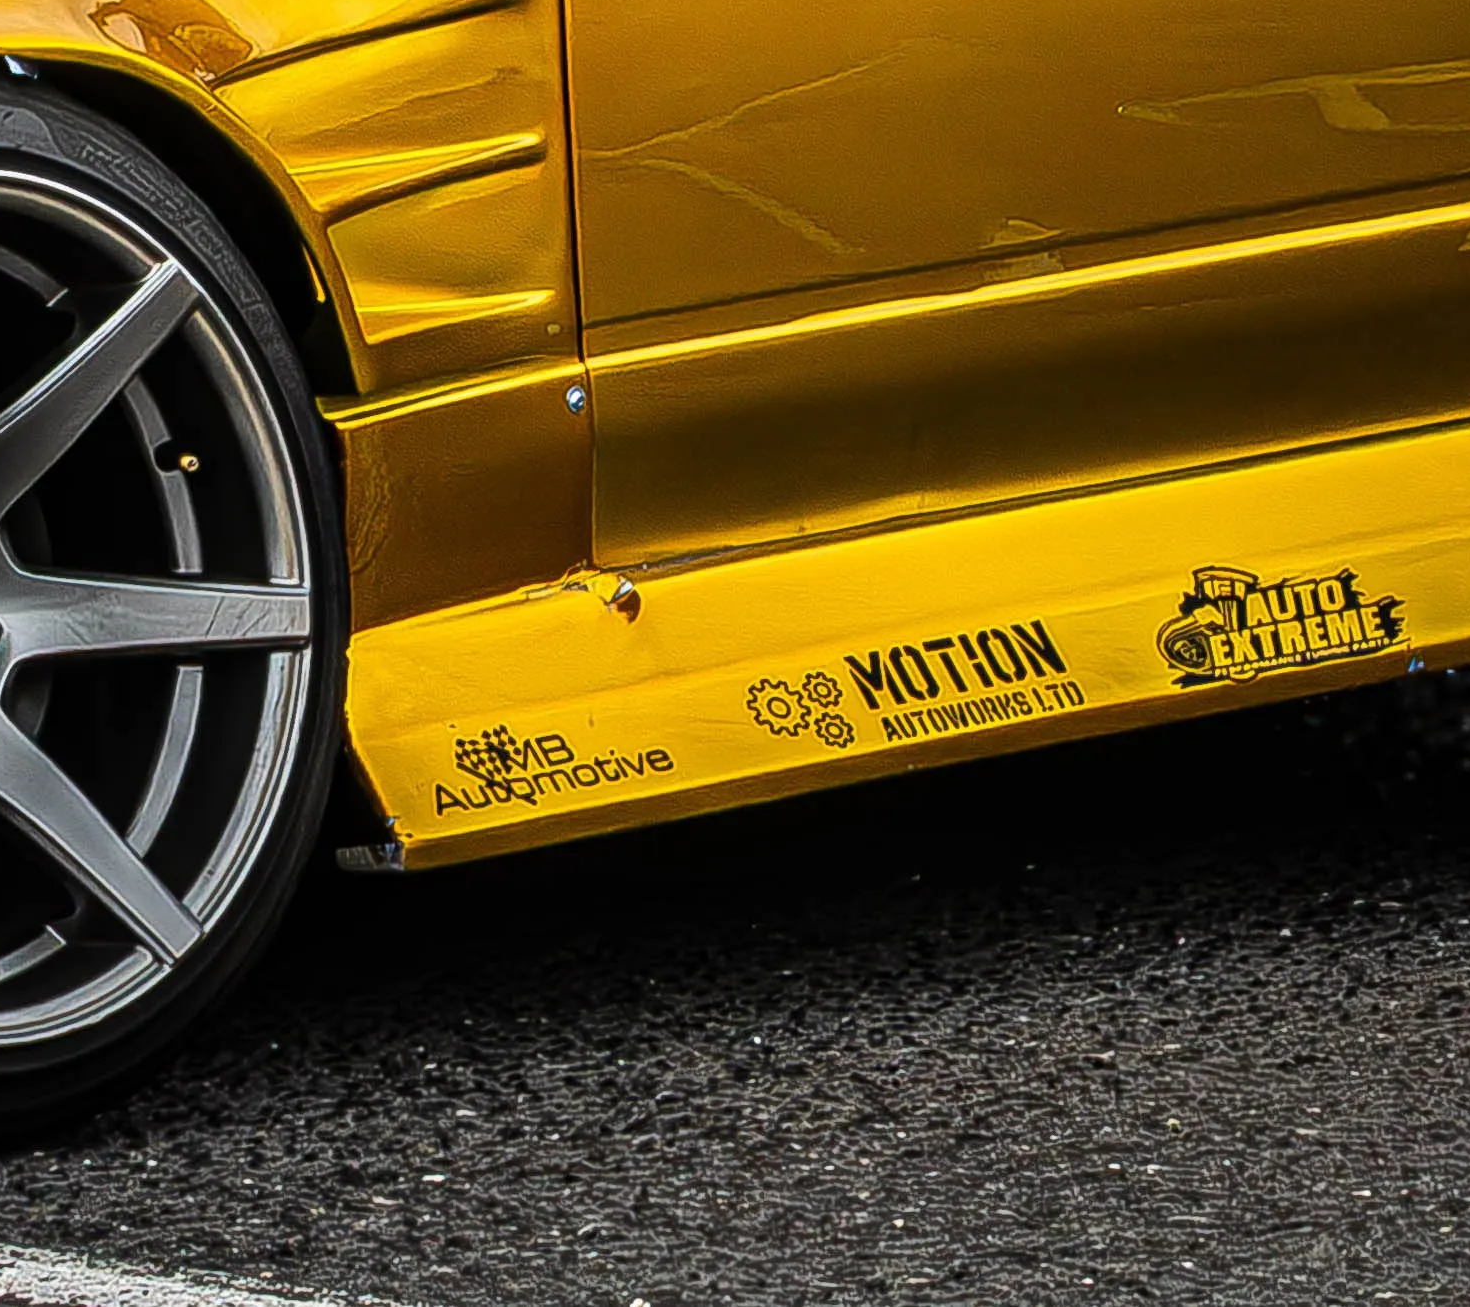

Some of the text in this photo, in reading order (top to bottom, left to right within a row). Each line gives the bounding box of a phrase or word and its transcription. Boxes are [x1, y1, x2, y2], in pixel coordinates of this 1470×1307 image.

[1245, 579, 1347, 627] AUTO
[842, 619, 1067, 710] MOTION
[1209, 606, 1386, 667] EXTREME
[881, 681, 1086, 742] AUTOWORKS LTD
[435, 748, 675, 816] Automotive
